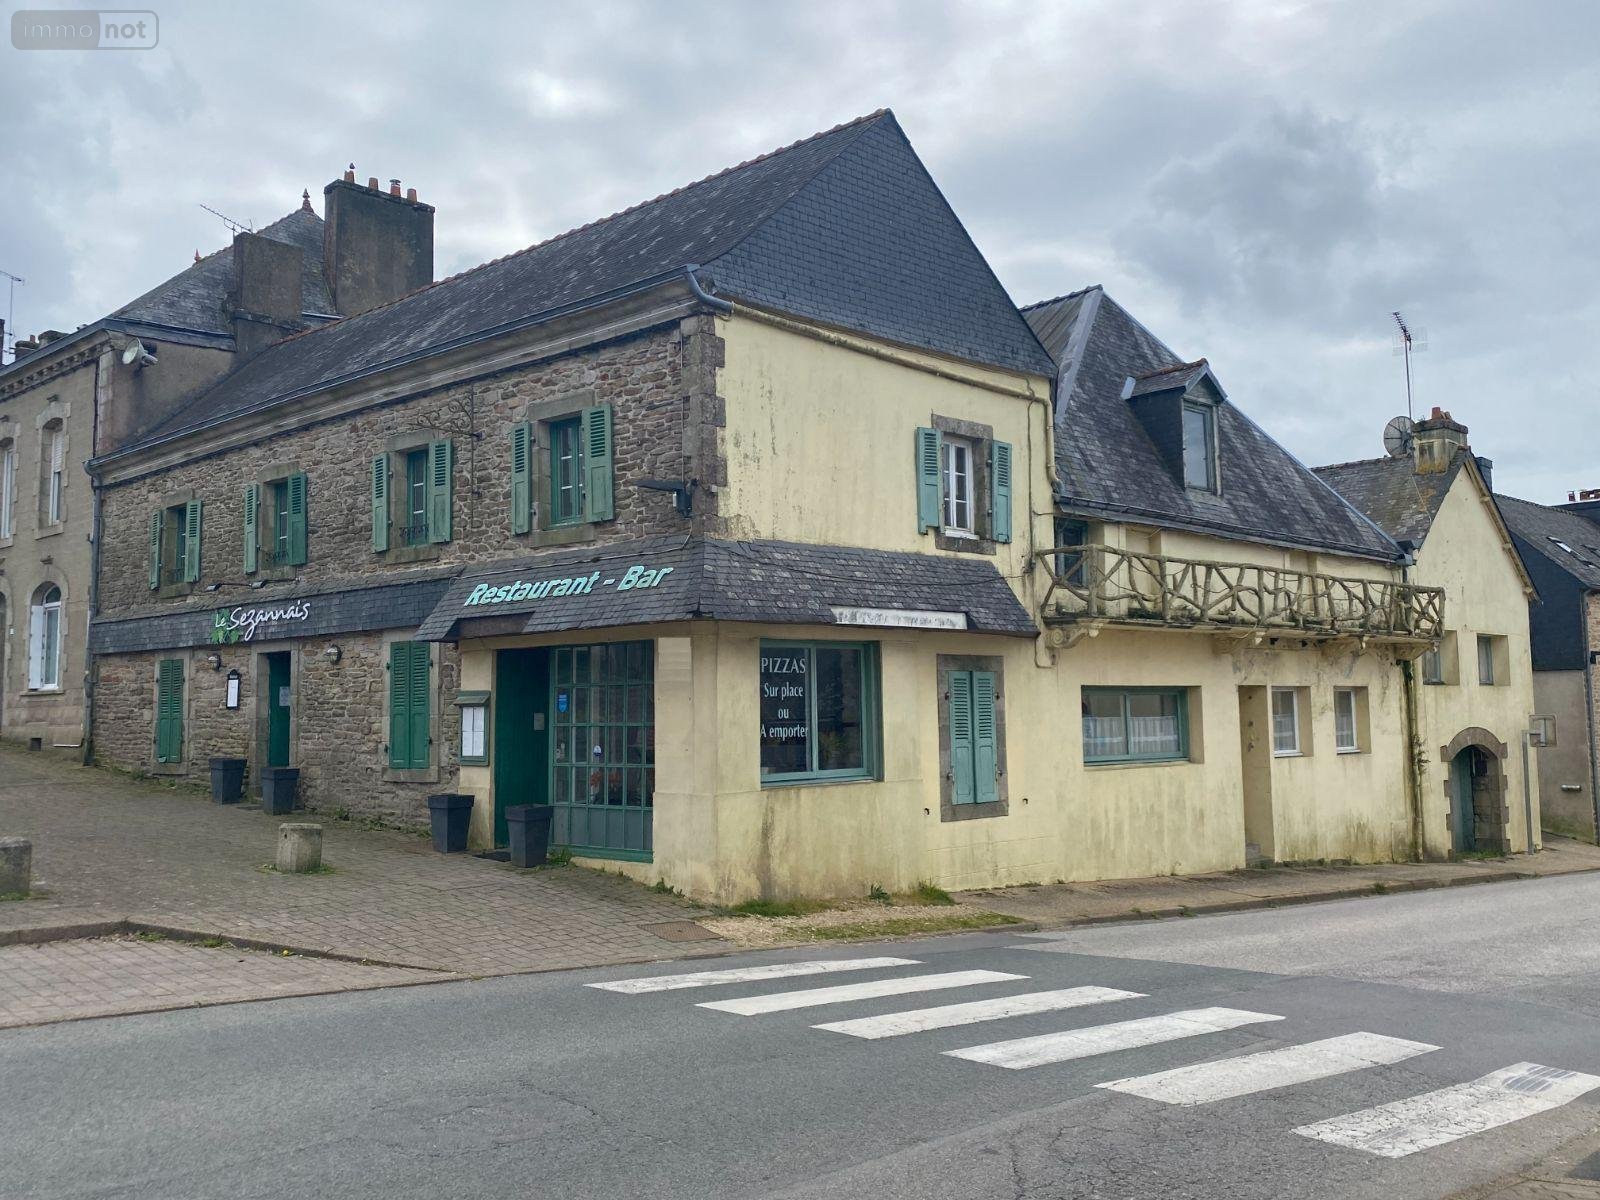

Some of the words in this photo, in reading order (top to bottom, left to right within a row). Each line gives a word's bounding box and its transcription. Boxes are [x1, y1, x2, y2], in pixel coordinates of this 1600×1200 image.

[463, 571, 601, 607] Restaurant
[617, 565, 674, 591] Bar
[215, 614, 227, 628] Le
[226, 600, 311, 641] Sezannais
[761, 657, 806, 674] PIZZAS
[764, 682, 778, 697] Sur
[781, 682, 803, 700] place
[778, 708, 789, 719] ou
[760, 724, 767, 738] A
[769, 724, 808, 741] emporter
